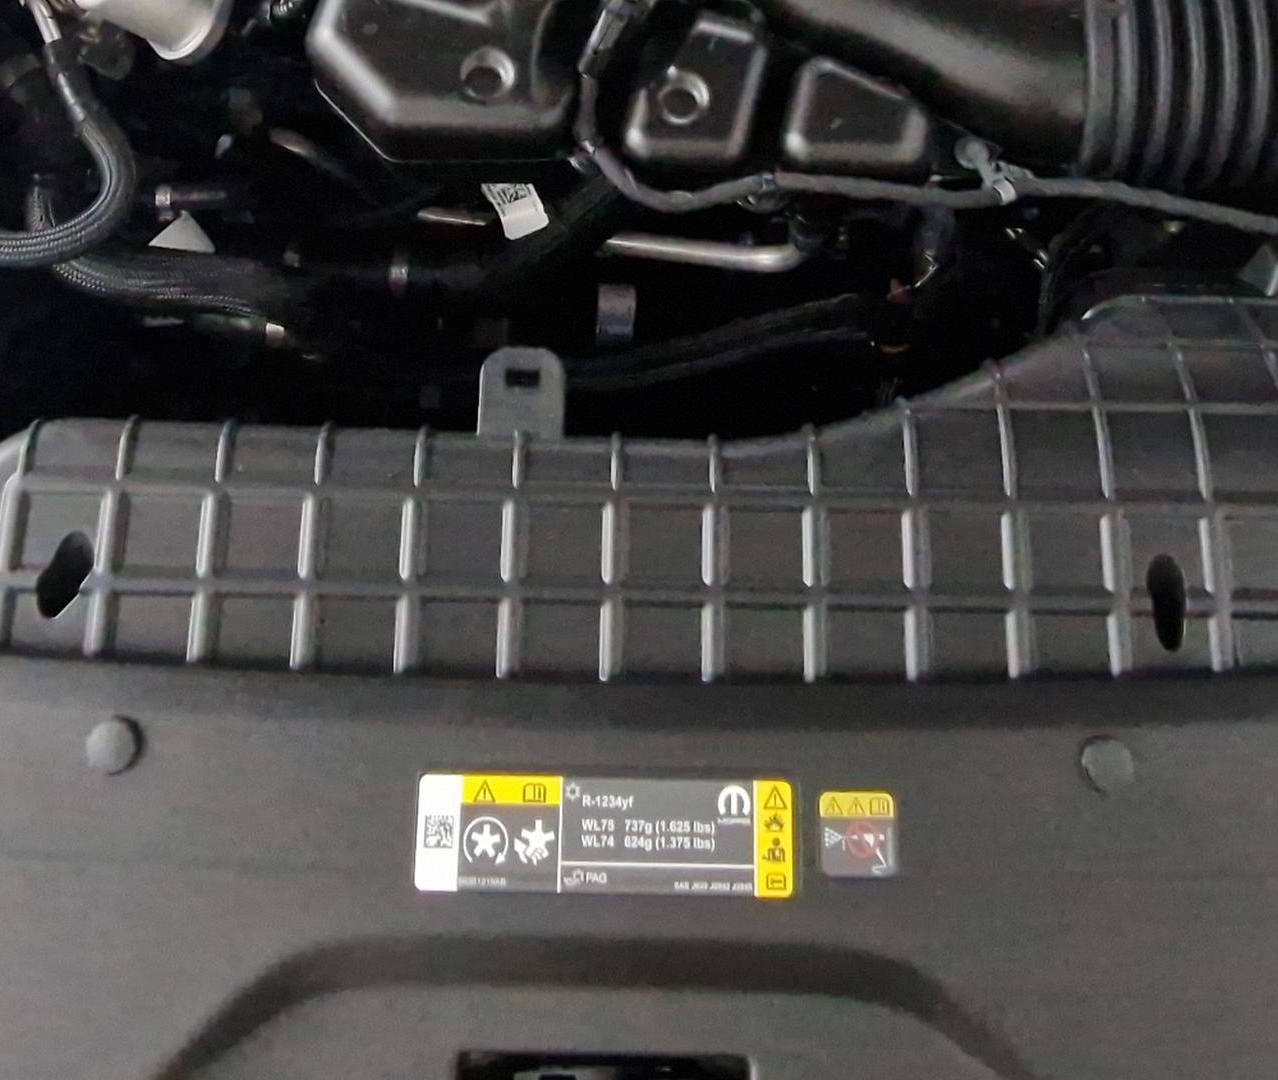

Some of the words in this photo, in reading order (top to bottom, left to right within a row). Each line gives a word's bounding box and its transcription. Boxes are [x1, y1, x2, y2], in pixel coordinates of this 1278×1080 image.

[582, 794, 634, 811] R-1234yf
[581, 819, 615, 832] WL75
[624, 819, 652, 835] 737g
[655, 820, 691, 834] (1.625
[693, 820, 715, 835] lbs)
[581, 834, 615, 848] WL74
[655, 836, 691, 851] (1.375
[693, 836, 715, 852] lbs)
[585, 872, 608, 884] PAG
